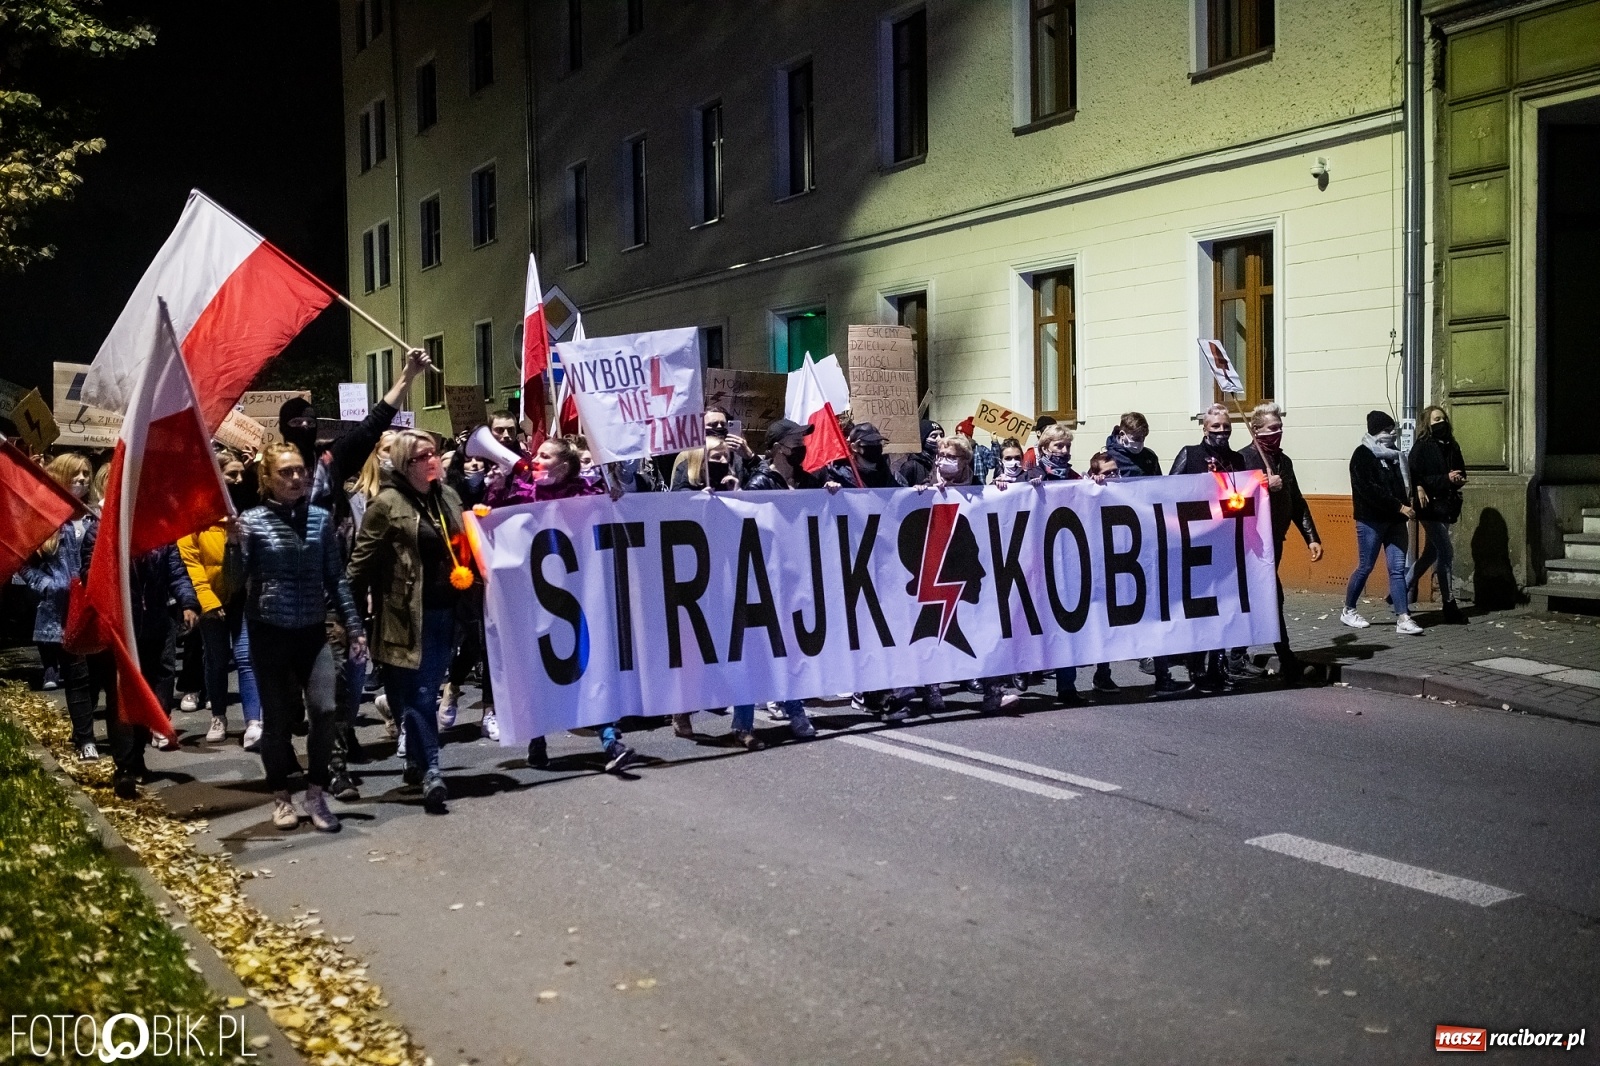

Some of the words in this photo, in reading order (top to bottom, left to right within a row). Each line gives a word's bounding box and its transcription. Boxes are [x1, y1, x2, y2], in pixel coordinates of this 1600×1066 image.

[866, 327, 900, 338] CHCEMY
[890, 341, 897, 352] Z
[852, 355, 890, 368] MIŁOŚCI
[563, 350, 646, 394] WYBÓR
[854, 384, 863, 396] Z
[617, 389, 655, 423] NIE
[732, 408, 753, 418] NIE
[862, 399, 915, 416] TERRORU
[1006, 416, 1033, 437] OFF
[530, 514, 896, 686] STRAJK
[987, 496, 1256, 640] KOBIET
